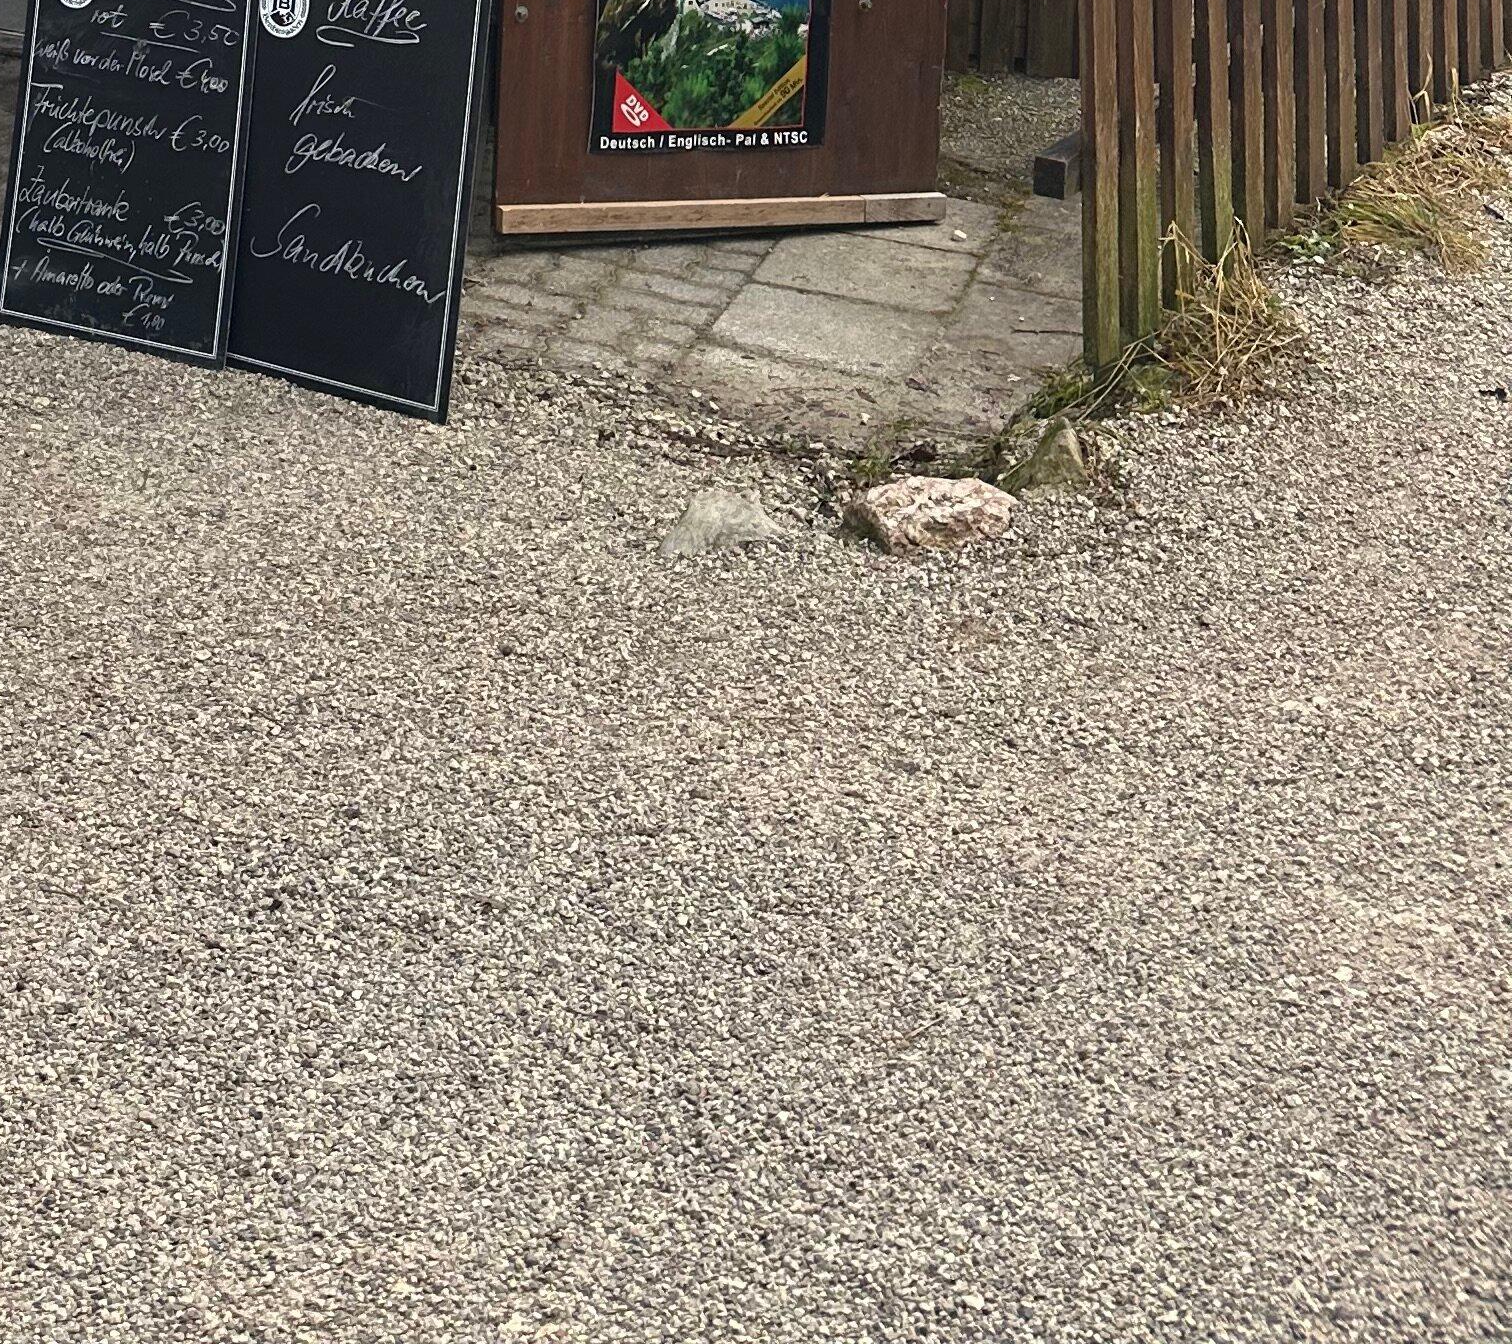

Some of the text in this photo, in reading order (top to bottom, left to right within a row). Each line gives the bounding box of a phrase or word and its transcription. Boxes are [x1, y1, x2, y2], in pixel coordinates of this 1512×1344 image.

[90, 4, 128, 28] rot
[624, 93, 650, 123] DVD
[599, 135, 656, 150] Deutsch
[668, 133, 731, 152] Englisch-
[735, 133, 757, 147] Pal
[760, 132, 770, 146] &
[773, 130, 809, 145] NTSC
[138, 224, 171, 259] halb
[97, 275, 127, 295] oder
